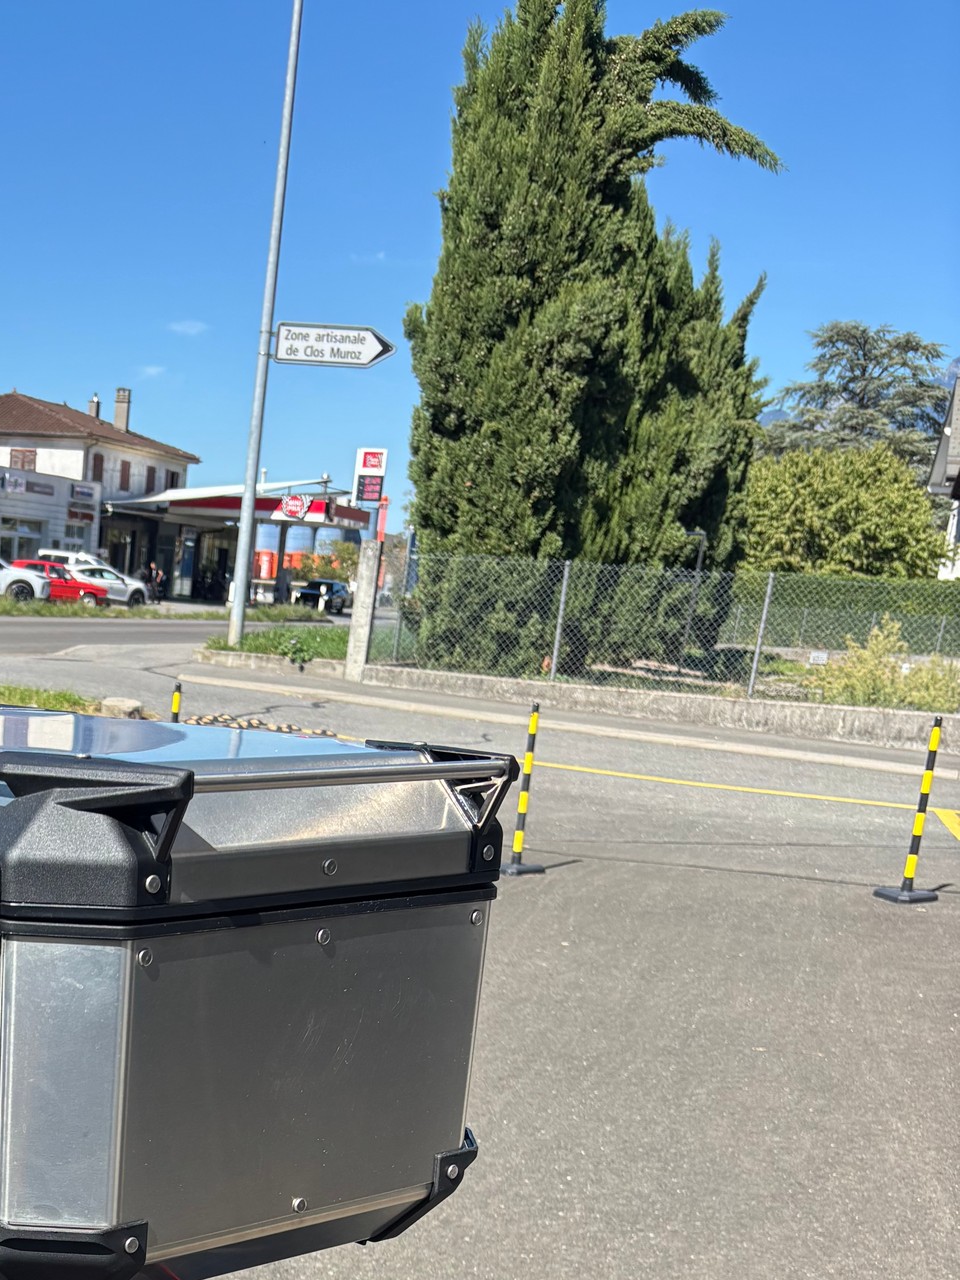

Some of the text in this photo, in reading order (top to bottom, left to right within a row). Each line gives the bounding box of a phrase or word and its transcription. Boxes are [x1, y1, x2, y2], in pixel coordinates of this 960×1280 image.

[285, 328, 366, 345] Zone artisanale
[286, 344, 362, 360] de Clos Muroz
